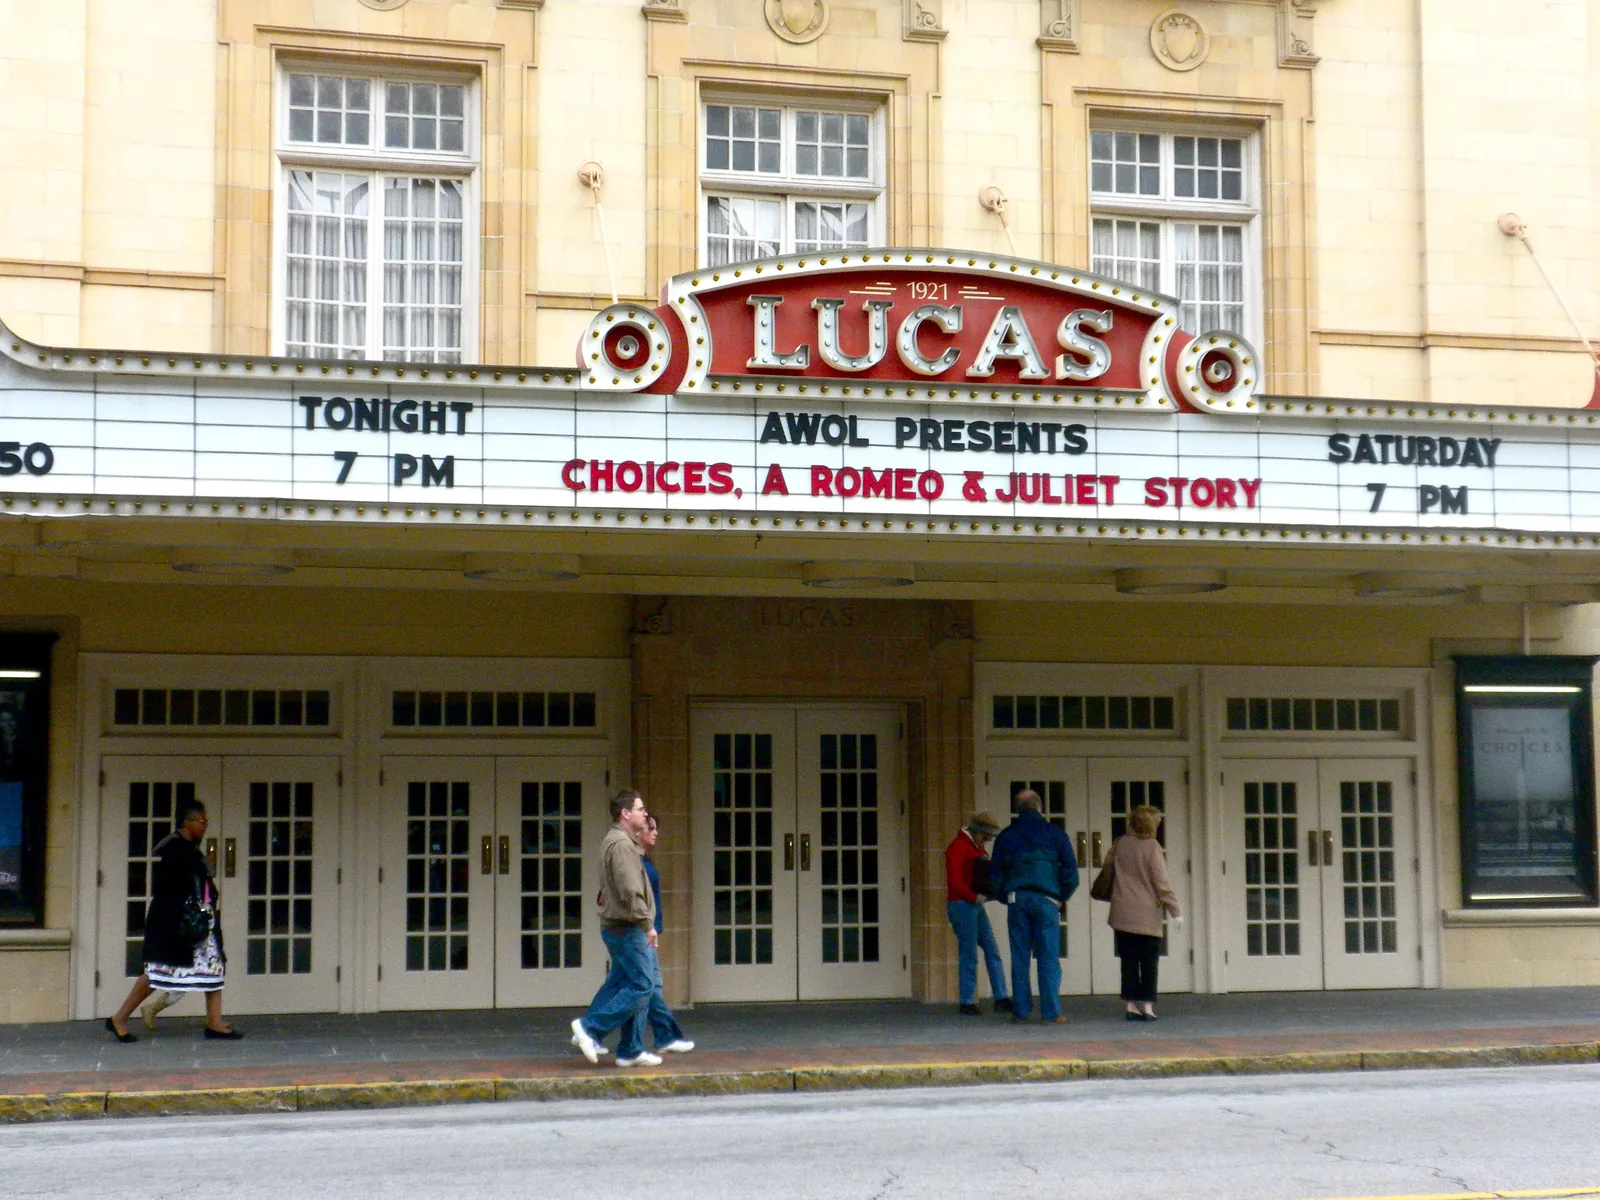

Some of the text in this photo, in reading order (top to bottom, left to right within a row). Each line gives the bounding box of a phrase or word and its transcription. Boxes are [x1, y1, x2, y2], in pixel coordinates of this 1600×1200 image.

[907, 281, 950, 301] 1921
[746, 294, 1114, 381] LUCAS
[299, 396, 473, 434] TONIGHT
[759, 411, 1088, 454] AWOL PRESENTS
[1328, 433, 1502, 468] SATURDAY
[334, 452, 454, 487] 7 PM
[561, 458, 1263, 510] CHOICES, A ROMEO & JULIET STORY
[1367, 483, 1469, 515] 7 PM
[761, 604, 853, 627] LUCAS
